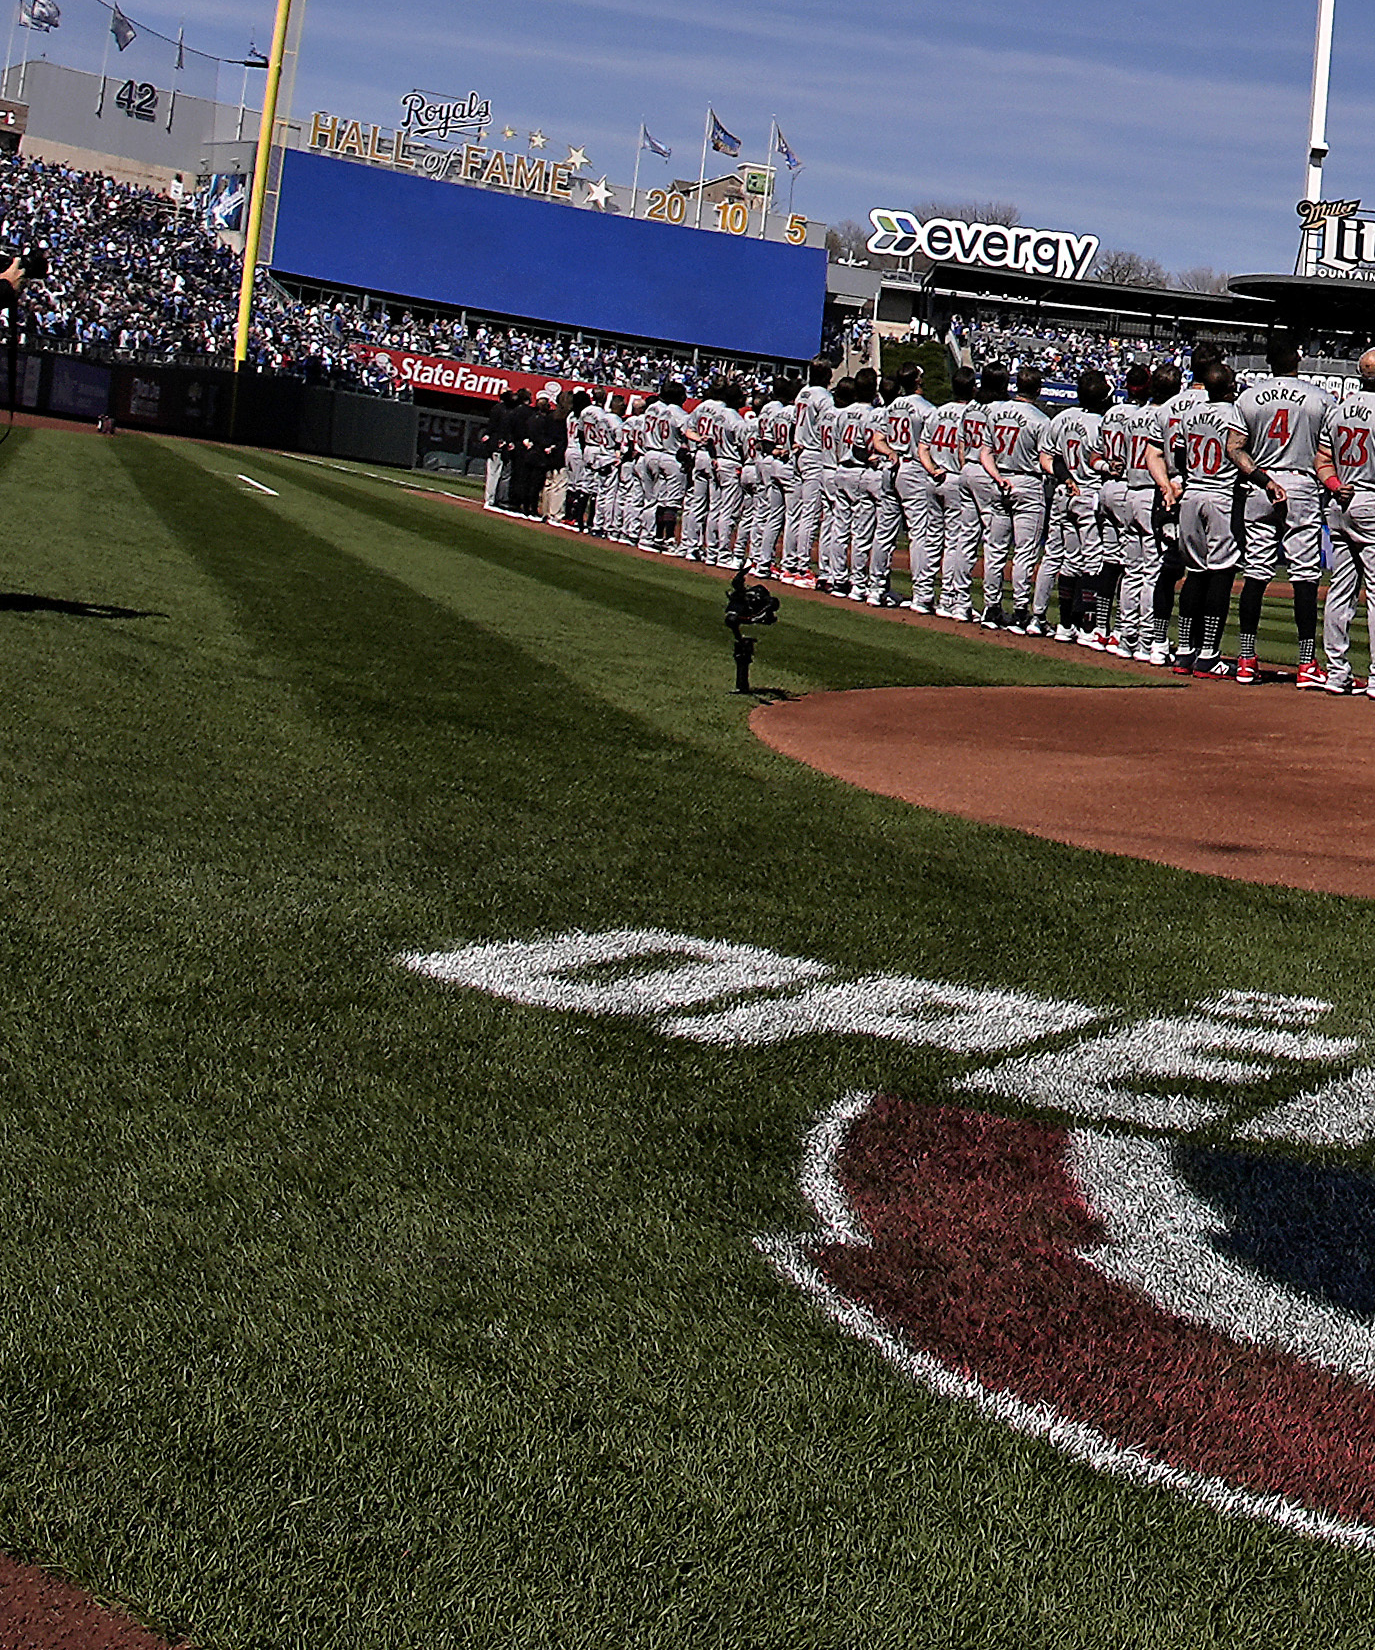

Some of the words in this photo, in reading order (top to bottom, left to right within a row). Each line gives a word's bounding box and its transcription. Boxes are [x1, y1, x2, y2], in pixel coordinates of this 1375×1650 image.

[115, 78, 157, 118] 42
[401, 90, 492, 139] Royals
[308, 110, 415, 168] HALL
[422, 144, 463, 181] of
[461, 143, 576, 200] FAME
[645, 188, 687, 225] 20
[714, 200, 749, 235] 10
[1297, 200, 1361, 230] Miller
[785, 212, 807, 246] 5
[924, 221, 1098, 280] evergy
[1255, 388, 1307, 406] CORREA
[888, 416, 911, 445] 38
[931, 424, 958, 454] 44
[994, 424, 1020, 455] 37
[1187, 411, 1224, 437] SANTANA
[1267, 408, 1291, 447] 4
[1187, 433, 1223, 475] 30
[1337, 425, 1371, 467] 23
